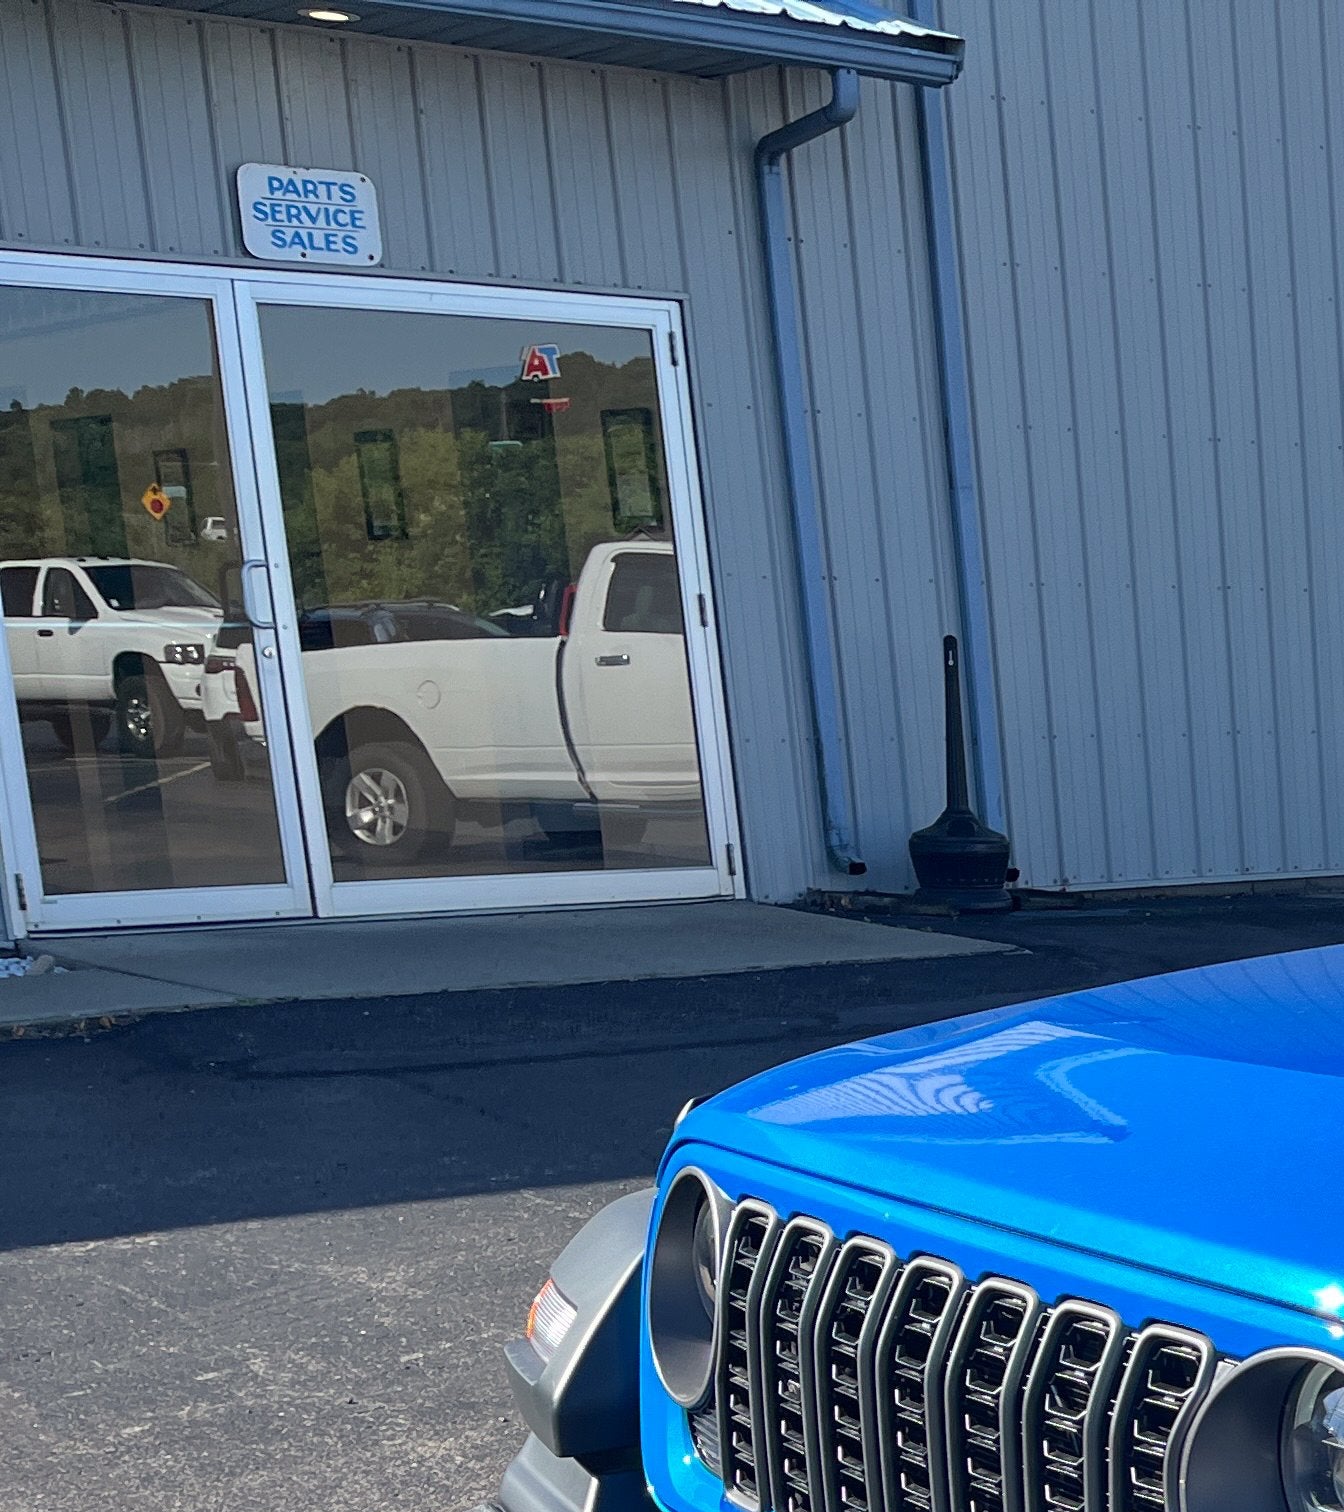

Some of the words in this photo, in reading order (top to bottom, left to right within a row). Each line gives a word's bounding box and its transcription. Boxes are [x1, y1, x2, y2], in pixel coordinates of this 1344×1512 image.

[267, 175, 357, 203] PARTS
[252, 201, 367, 229] SERVICE
[271, 229, 359, 255] SALES
